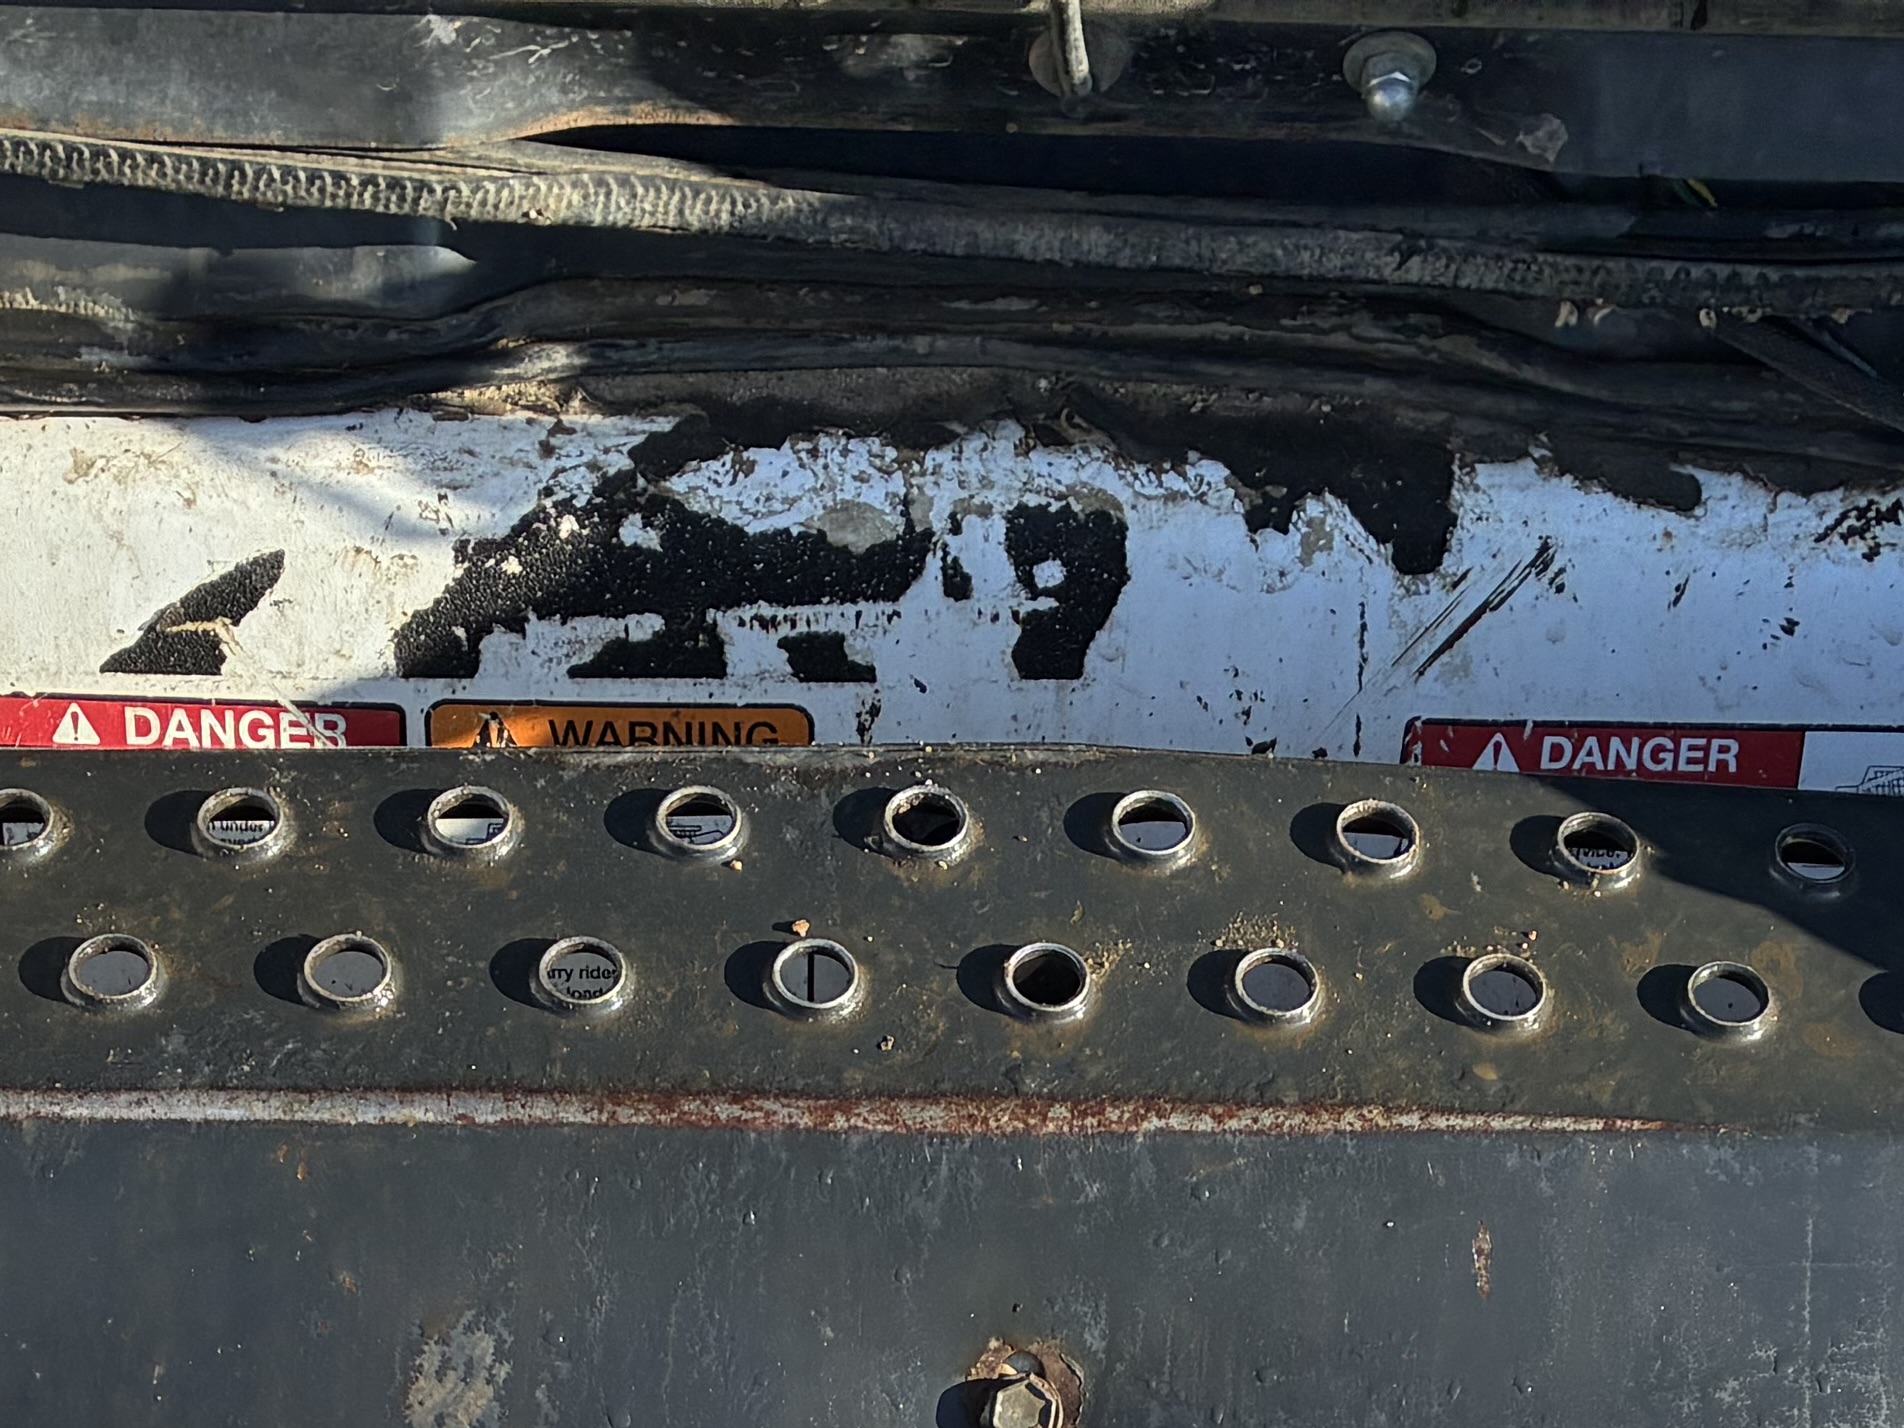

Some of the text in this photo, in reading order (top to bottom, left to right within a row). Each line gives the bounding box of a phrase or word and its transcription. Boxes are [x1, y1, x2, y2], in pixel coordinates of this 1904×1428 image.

[124, 706, 347, 749] DANGER
[548, 719, 780, 747] WARNING
[1539, 735, 1740, 773] DANGER
